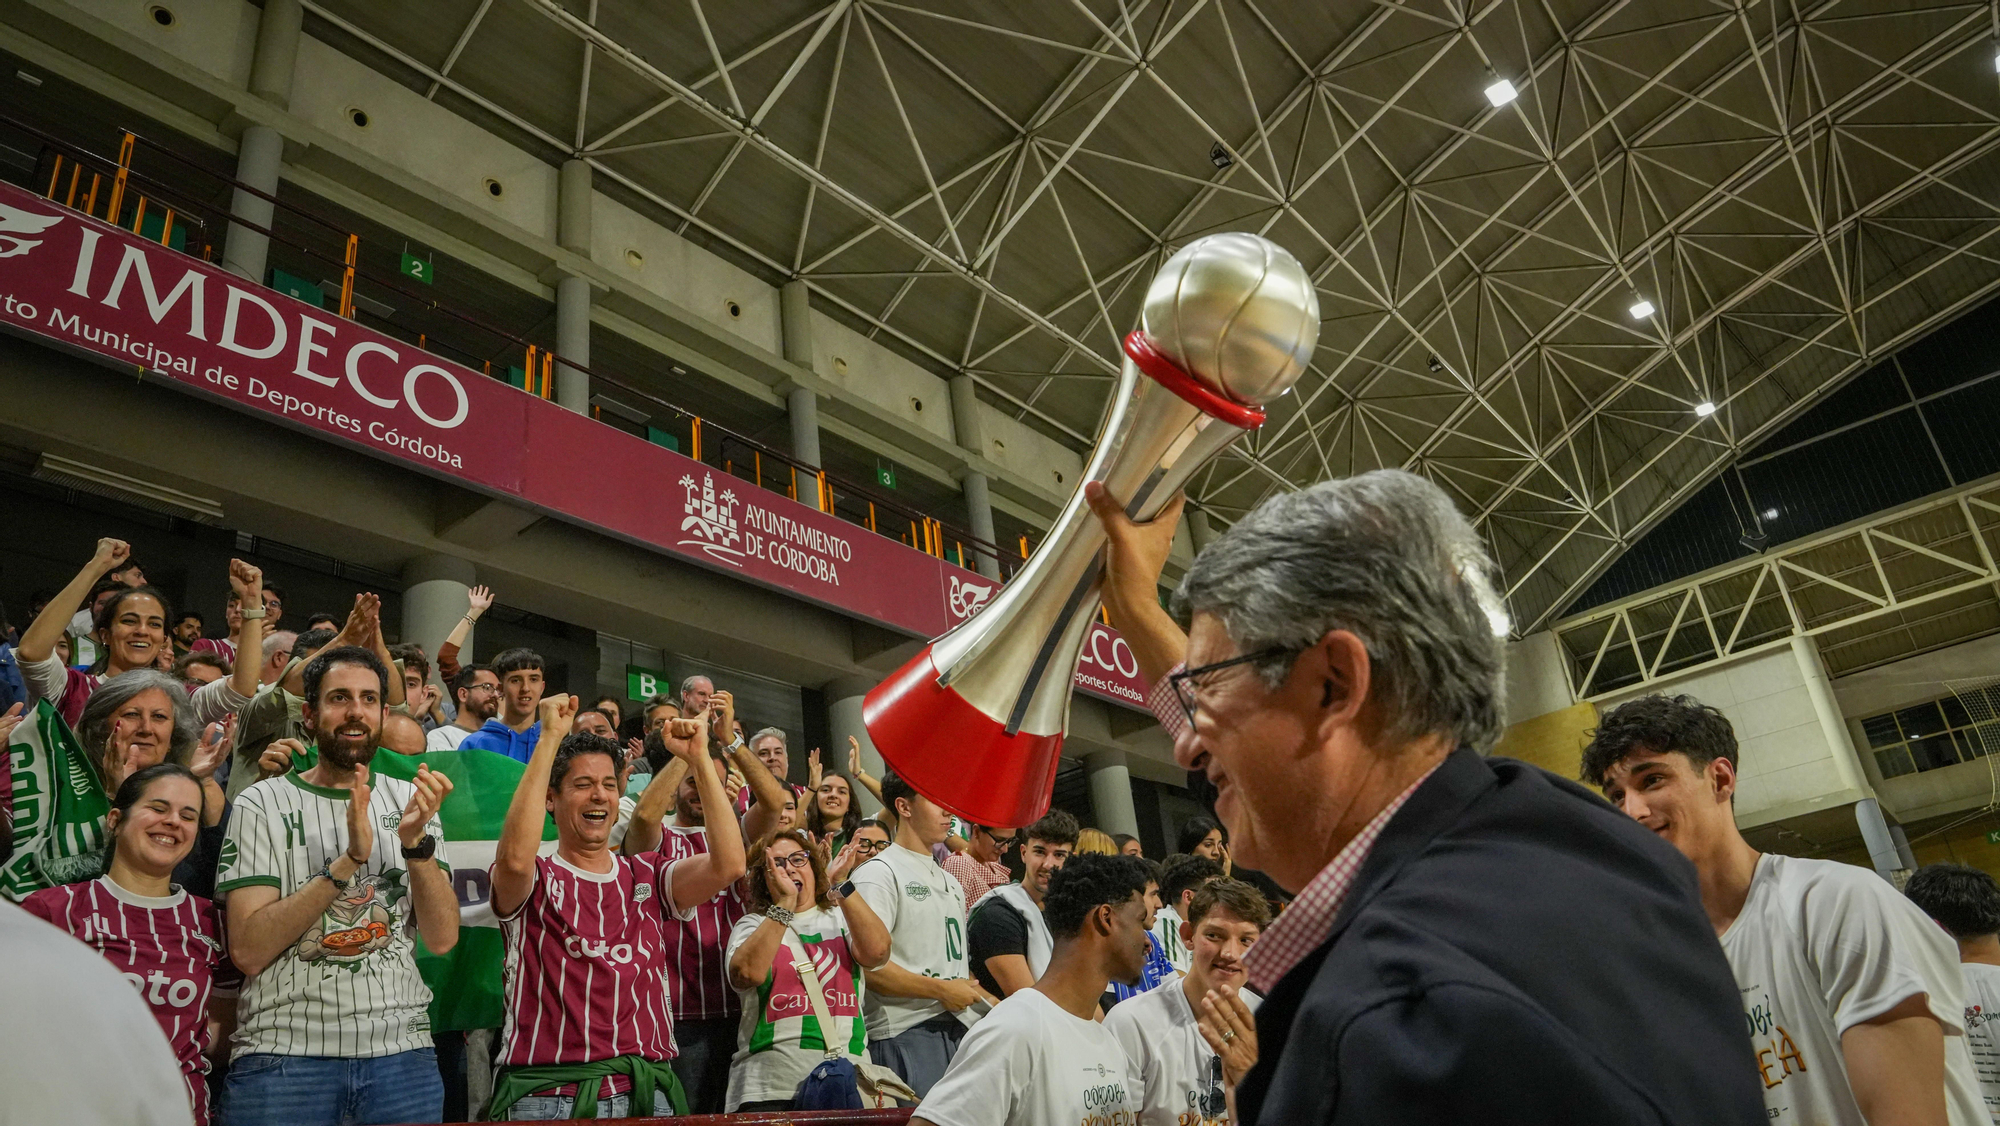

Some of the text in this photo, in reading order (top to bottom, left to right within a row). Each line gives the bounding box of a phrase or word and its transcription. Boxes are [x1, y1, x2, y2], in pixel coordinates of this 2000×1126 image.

[411, 261, 423, 277] 2
[66, 226, 469, 429] IMDECO
[0, 294, 463, 469] to Municipal de Deportes Córdoba
[883, 472, 891, 485] 3
[744, 503, 851, 562] AYUNTAMIENTO
[745, 531, 840, 586] DE CÓRDOBA
[640, 672, 657, 698] B
[1107, 680, 1144, 702] Córdoba
[1990, 831, 2000, 842] K
[944, 916, 963, 962] 10
[769, 988, 857, 1013] CajSur
